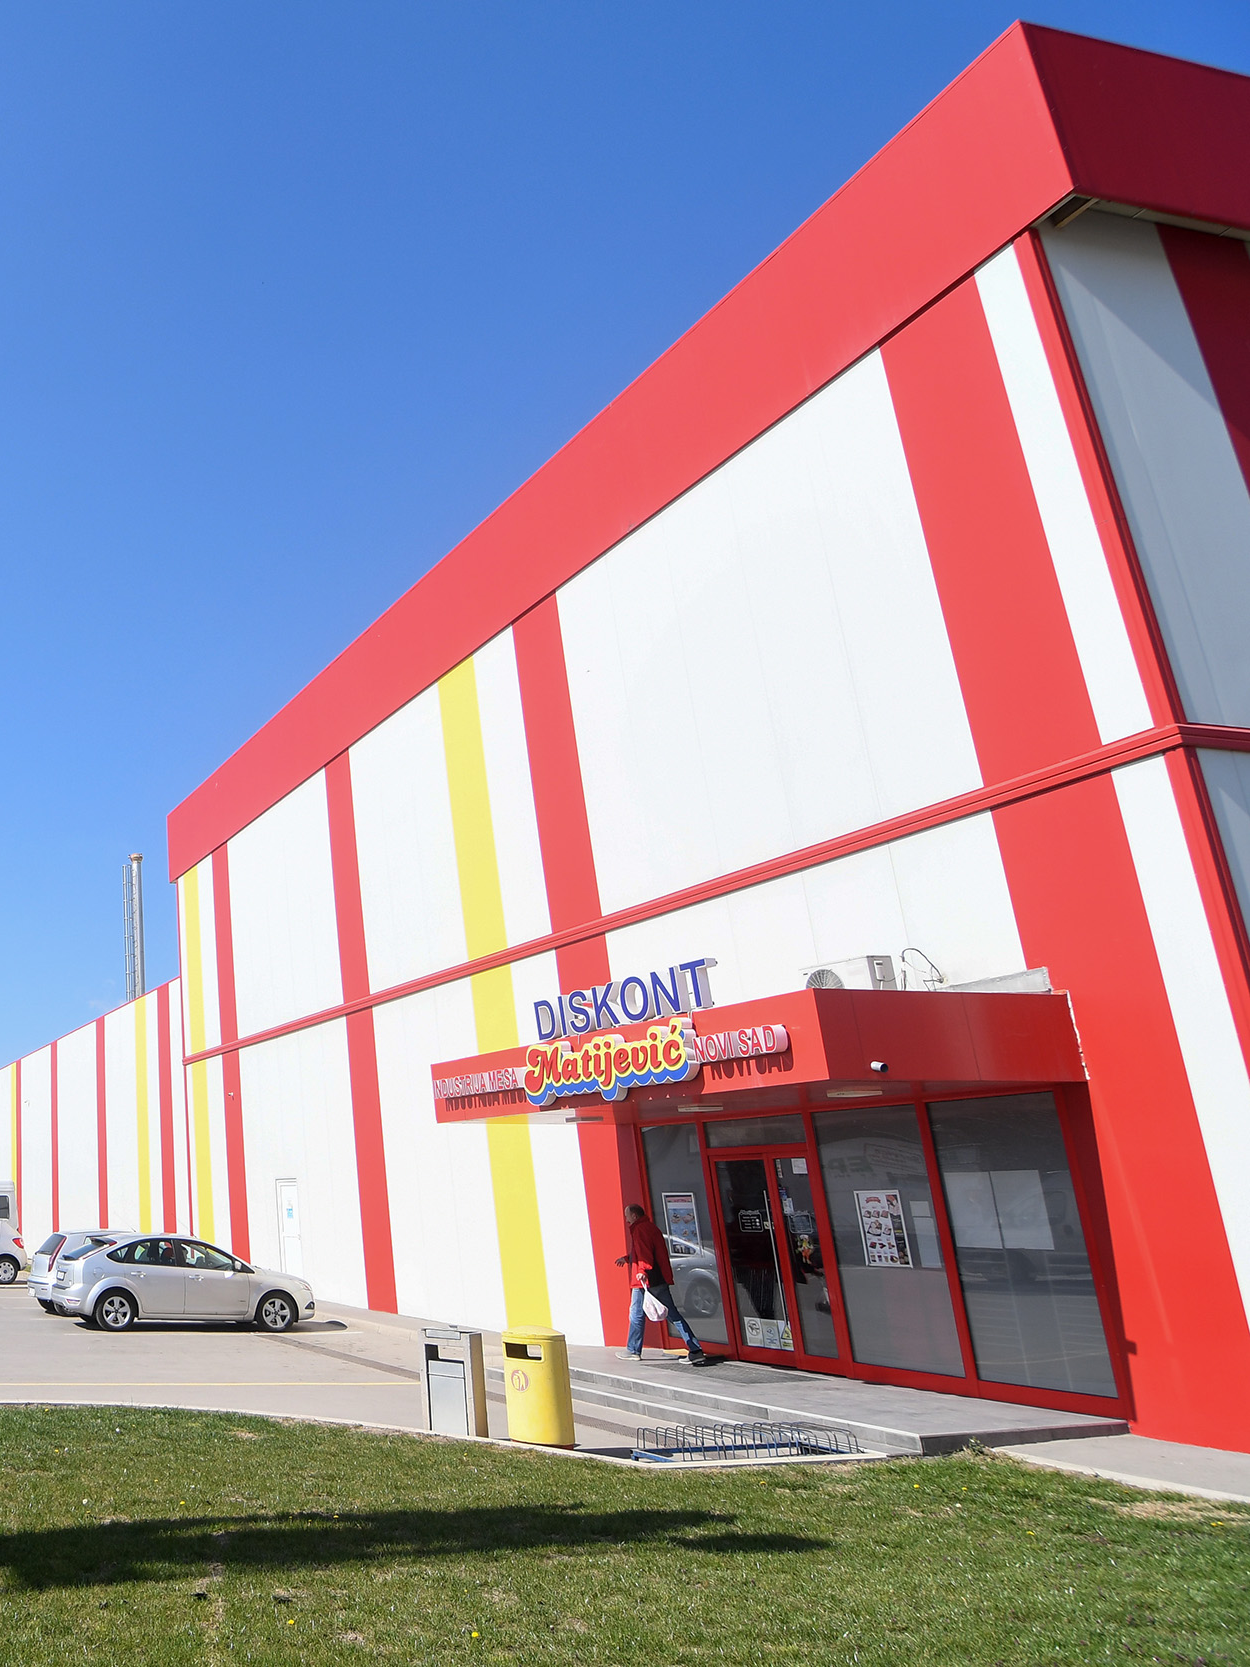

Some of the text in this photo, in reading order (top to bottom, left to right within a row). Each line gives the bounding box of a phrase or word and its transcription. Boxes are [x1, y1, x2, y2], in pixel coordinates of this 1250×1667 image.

[533, 957, 708, 1042] DISKONT
[488, 1068, 520, 1092] MESA
[523, 1022, 685, 1095] Matijević
[693, 1031, 734, 1062] NOVI
[737, 1025, 776, 1057] SAD
